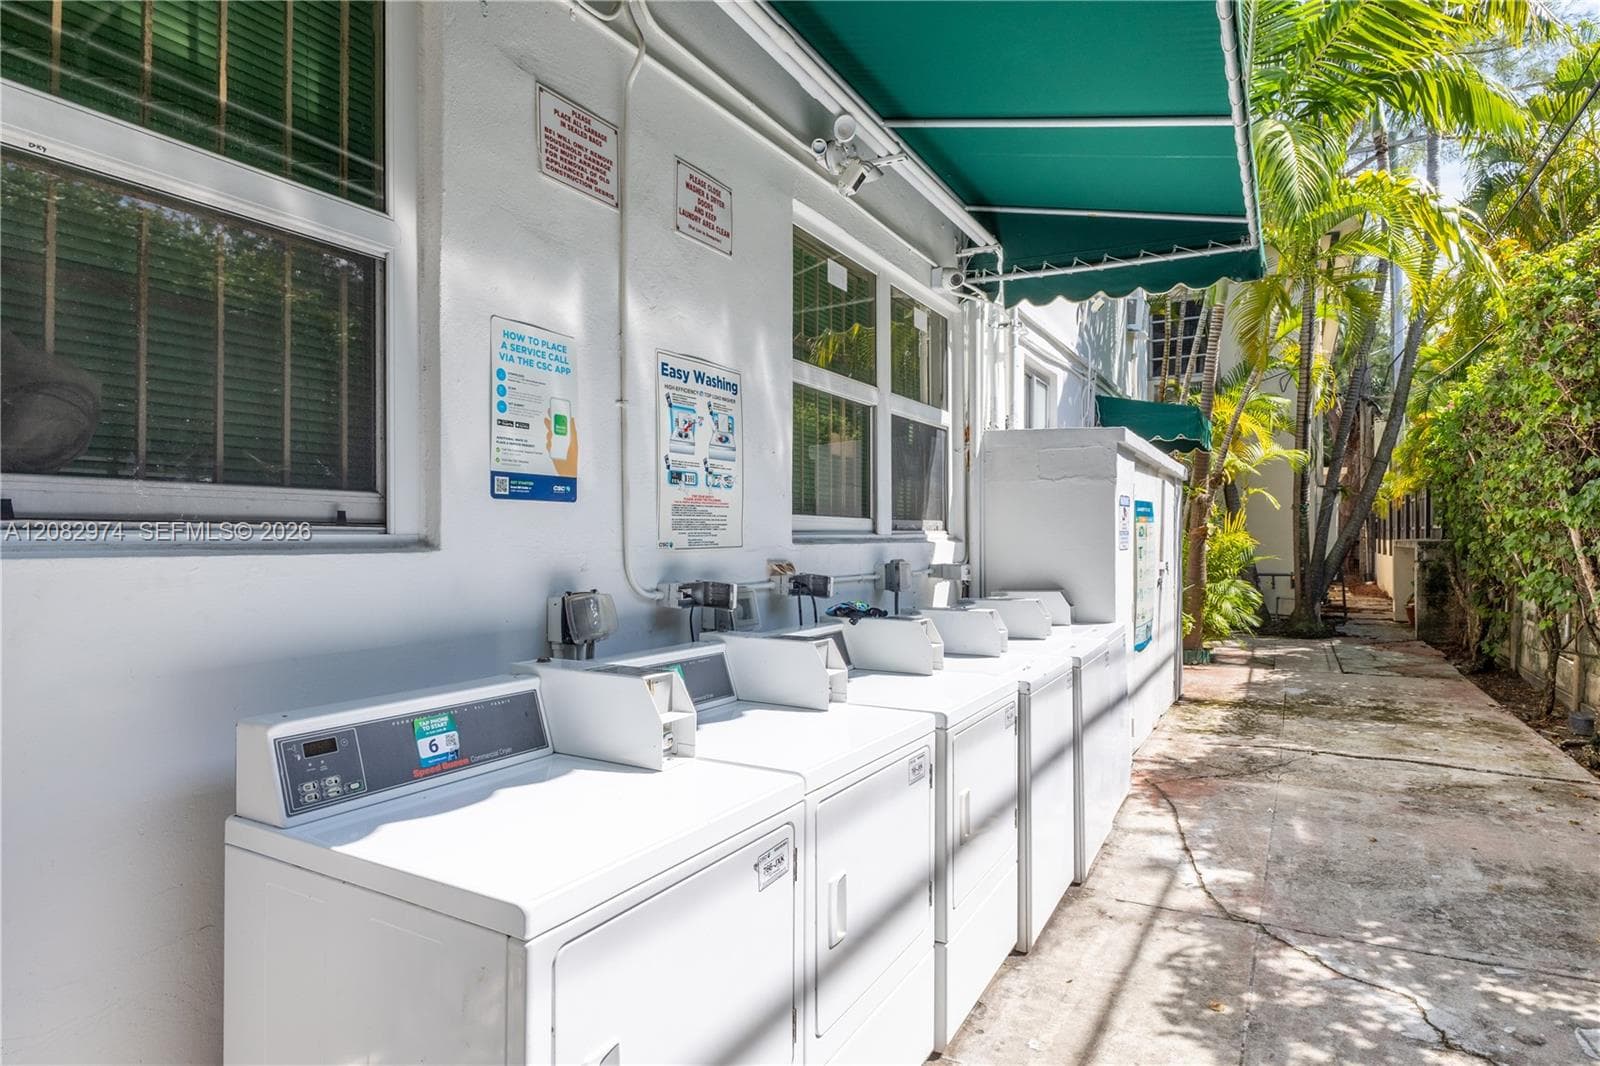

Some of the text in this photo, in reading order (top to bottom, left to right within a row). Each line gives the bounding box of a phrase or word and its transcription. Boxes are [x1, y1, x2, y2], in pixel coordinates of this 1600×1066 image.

[554, 108, 608, 143] PLACE ALL GARBAGE
[572, 110, 591, 125] PLEASE
[567, 123, 587, 139] SEALED
[589, 135, 602, 147] BAGS
[544, 134, 611, 171] HOUSEHOLD GARBAGE
[545, 141, 607, 176] YOU MUST ARRANGE
[557, 132, 571, 144] WILL
[573, 141, 588, 153] ONLY
[590, 150, 613, 166] REMOVE
[545, 148, 558, 159] FOR
[559, 156, 588, 174] REMOVAL
[599, 175, 610, 184] OLD
[546, 156, 598, 185] APPLIANCES AND
[545, 163, 614, 200] CONSTRUCTION DEBRIS
[689, 173, 721, 198] PLEASE CLOSE
[685, 181, 705, 197] WASHER
[710, 195, 725, 209] DRYER
[697, 198, 713, 212] DOORS
[679, 207, 730, 238] LAUNDRY AREA CLEAN
[694, 206, 717, 222] AND KEEP
[501, 341, 569, 365] A SERVICE CALL
[503, 330, 567, 353] HOW TO PLACE
[499, 352, 571, 375] VIA THE CSC APP
[661, 362, 738, 395] Easy Washing
[430, 722, 448, 731] START
[431, 716, 449, 724] PHONE
[428, 738, 439, 753] 6
[412, 764, 442, 778] Speed
[442, 758, 470, 770] Queen
[470, 751, 499, 762] Commercial
